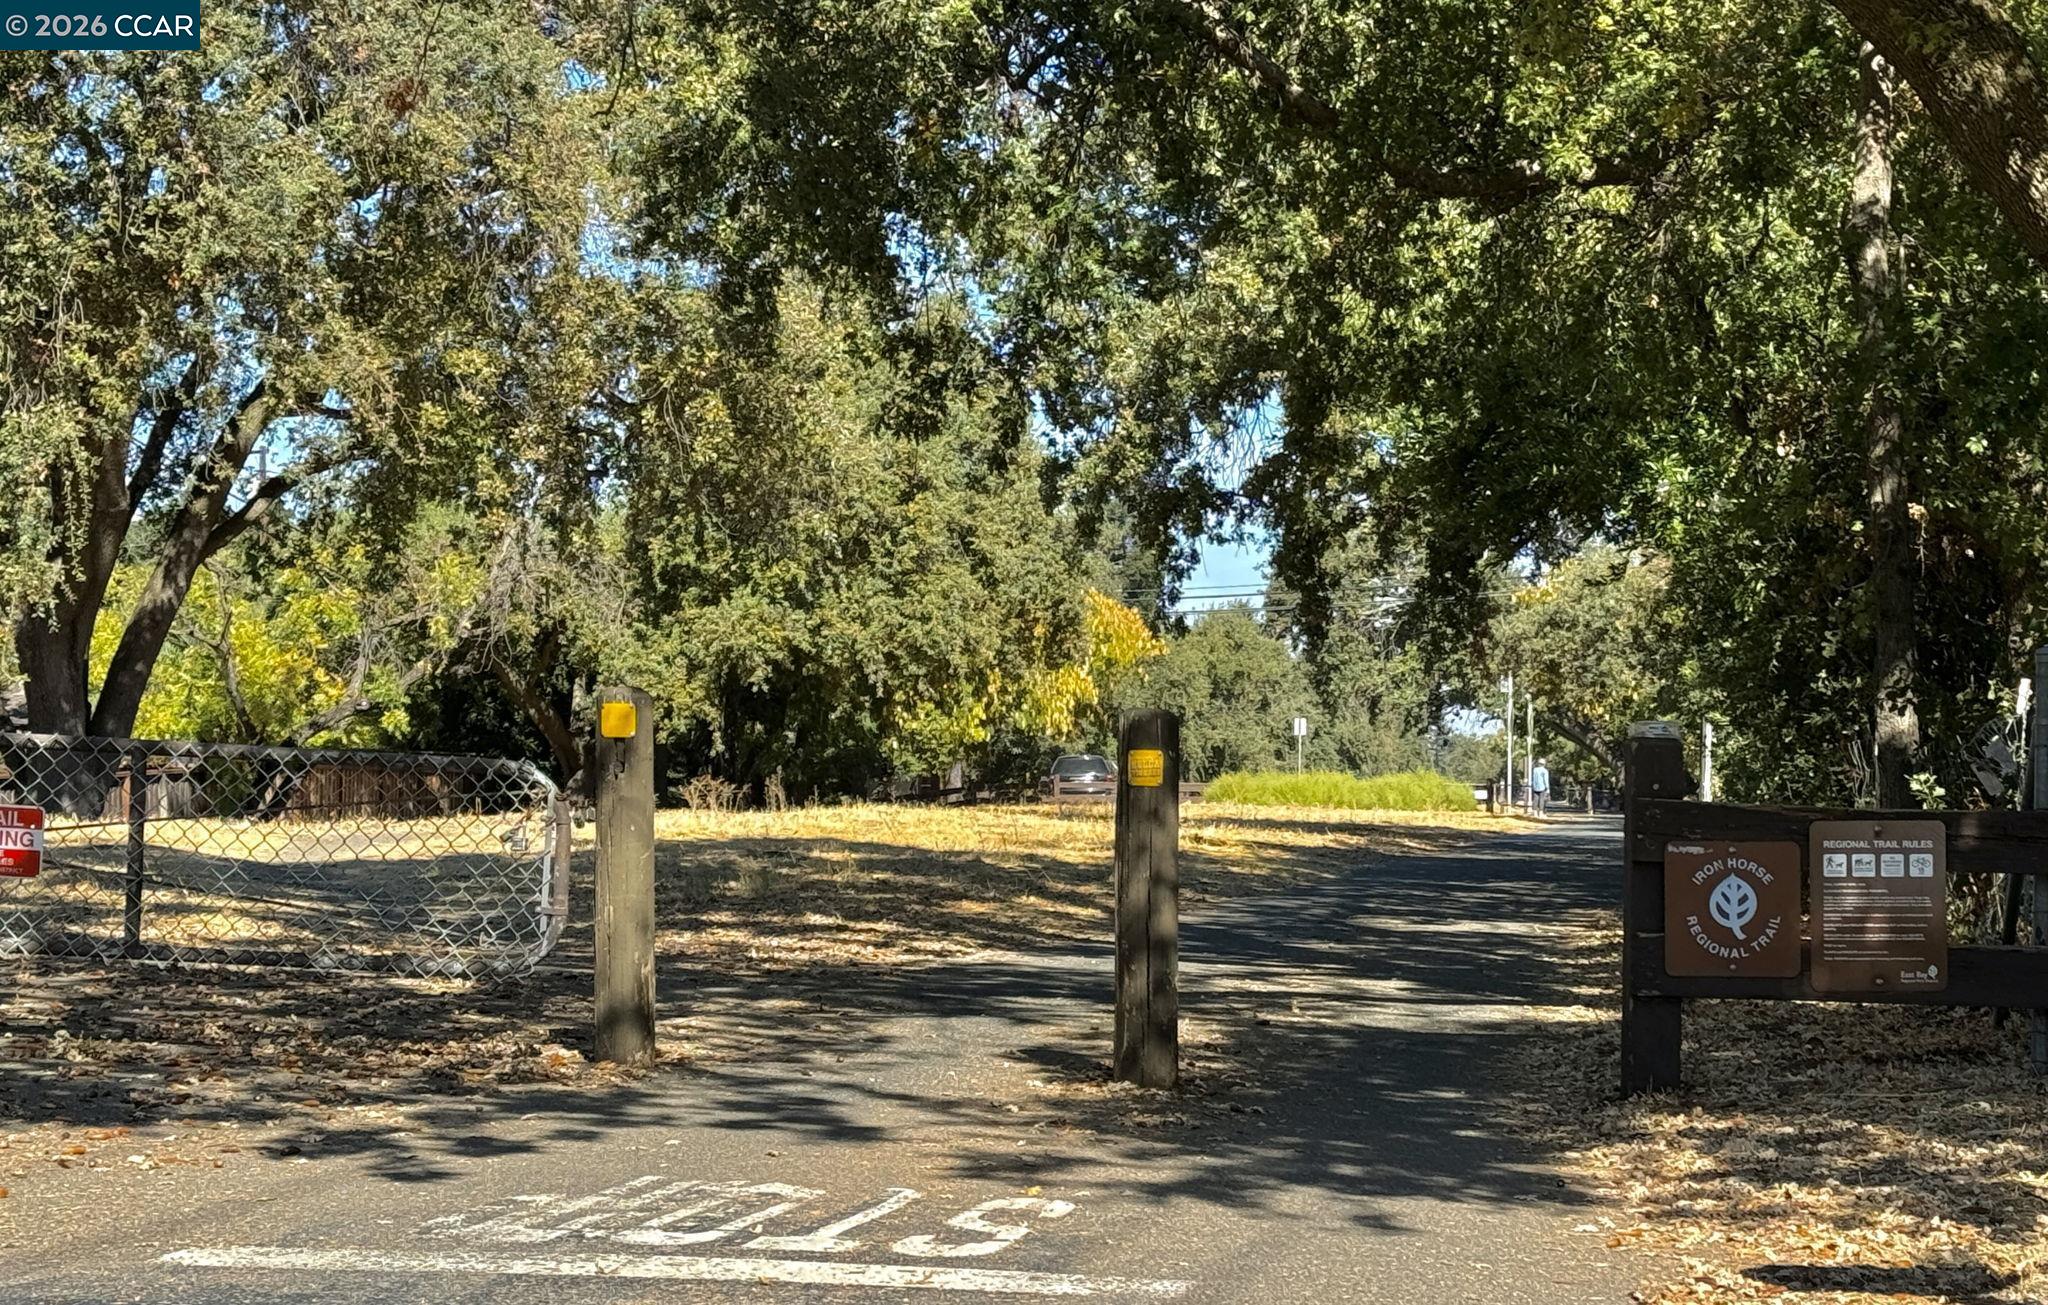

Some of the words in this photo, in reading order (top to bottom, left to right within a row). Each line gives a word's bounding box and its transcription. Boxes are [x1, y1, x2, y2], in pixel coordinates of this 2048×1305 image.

[1823, 840, 1870, 848] REGIONAL
[1873, 840, 1899, 848] TRAIL
[1902, 840, 1933, 848] RULES
[1691, 859, 1724, 886] IRON
[1727, 857, 1774, 886] HORSE
[1686, 915, 1750, 959] REGIONAL
[1750, 915, 1782, 952] TRAIL
